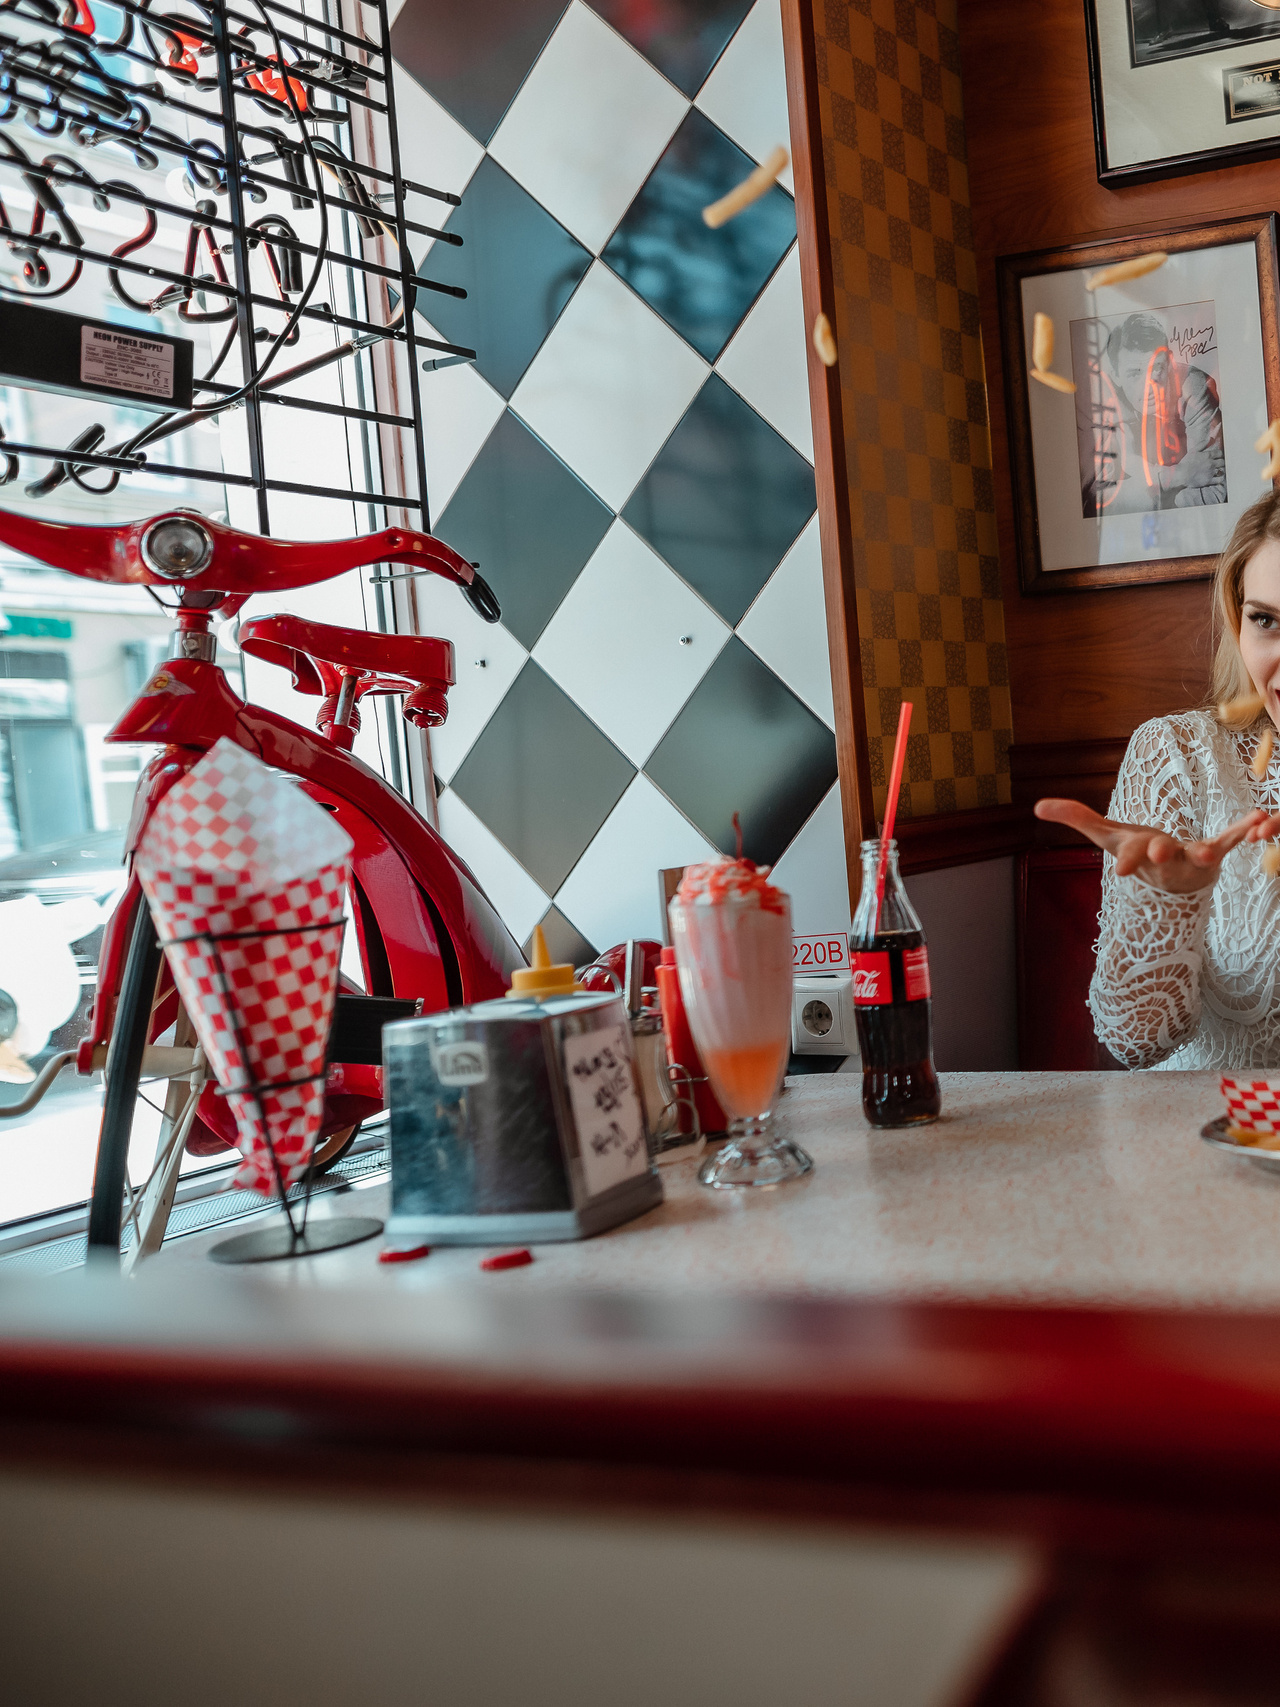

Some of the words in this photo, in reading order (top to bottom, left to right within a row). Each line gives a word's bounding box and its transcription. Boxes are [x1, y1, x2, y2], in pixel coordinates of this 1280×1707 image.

[1243, 73, 1272, 87] NOT
[94, 331, 111, 342] NEON
[113, 336, 137, 347] POWER
[139, 341, 164, 352] SUPPLY
